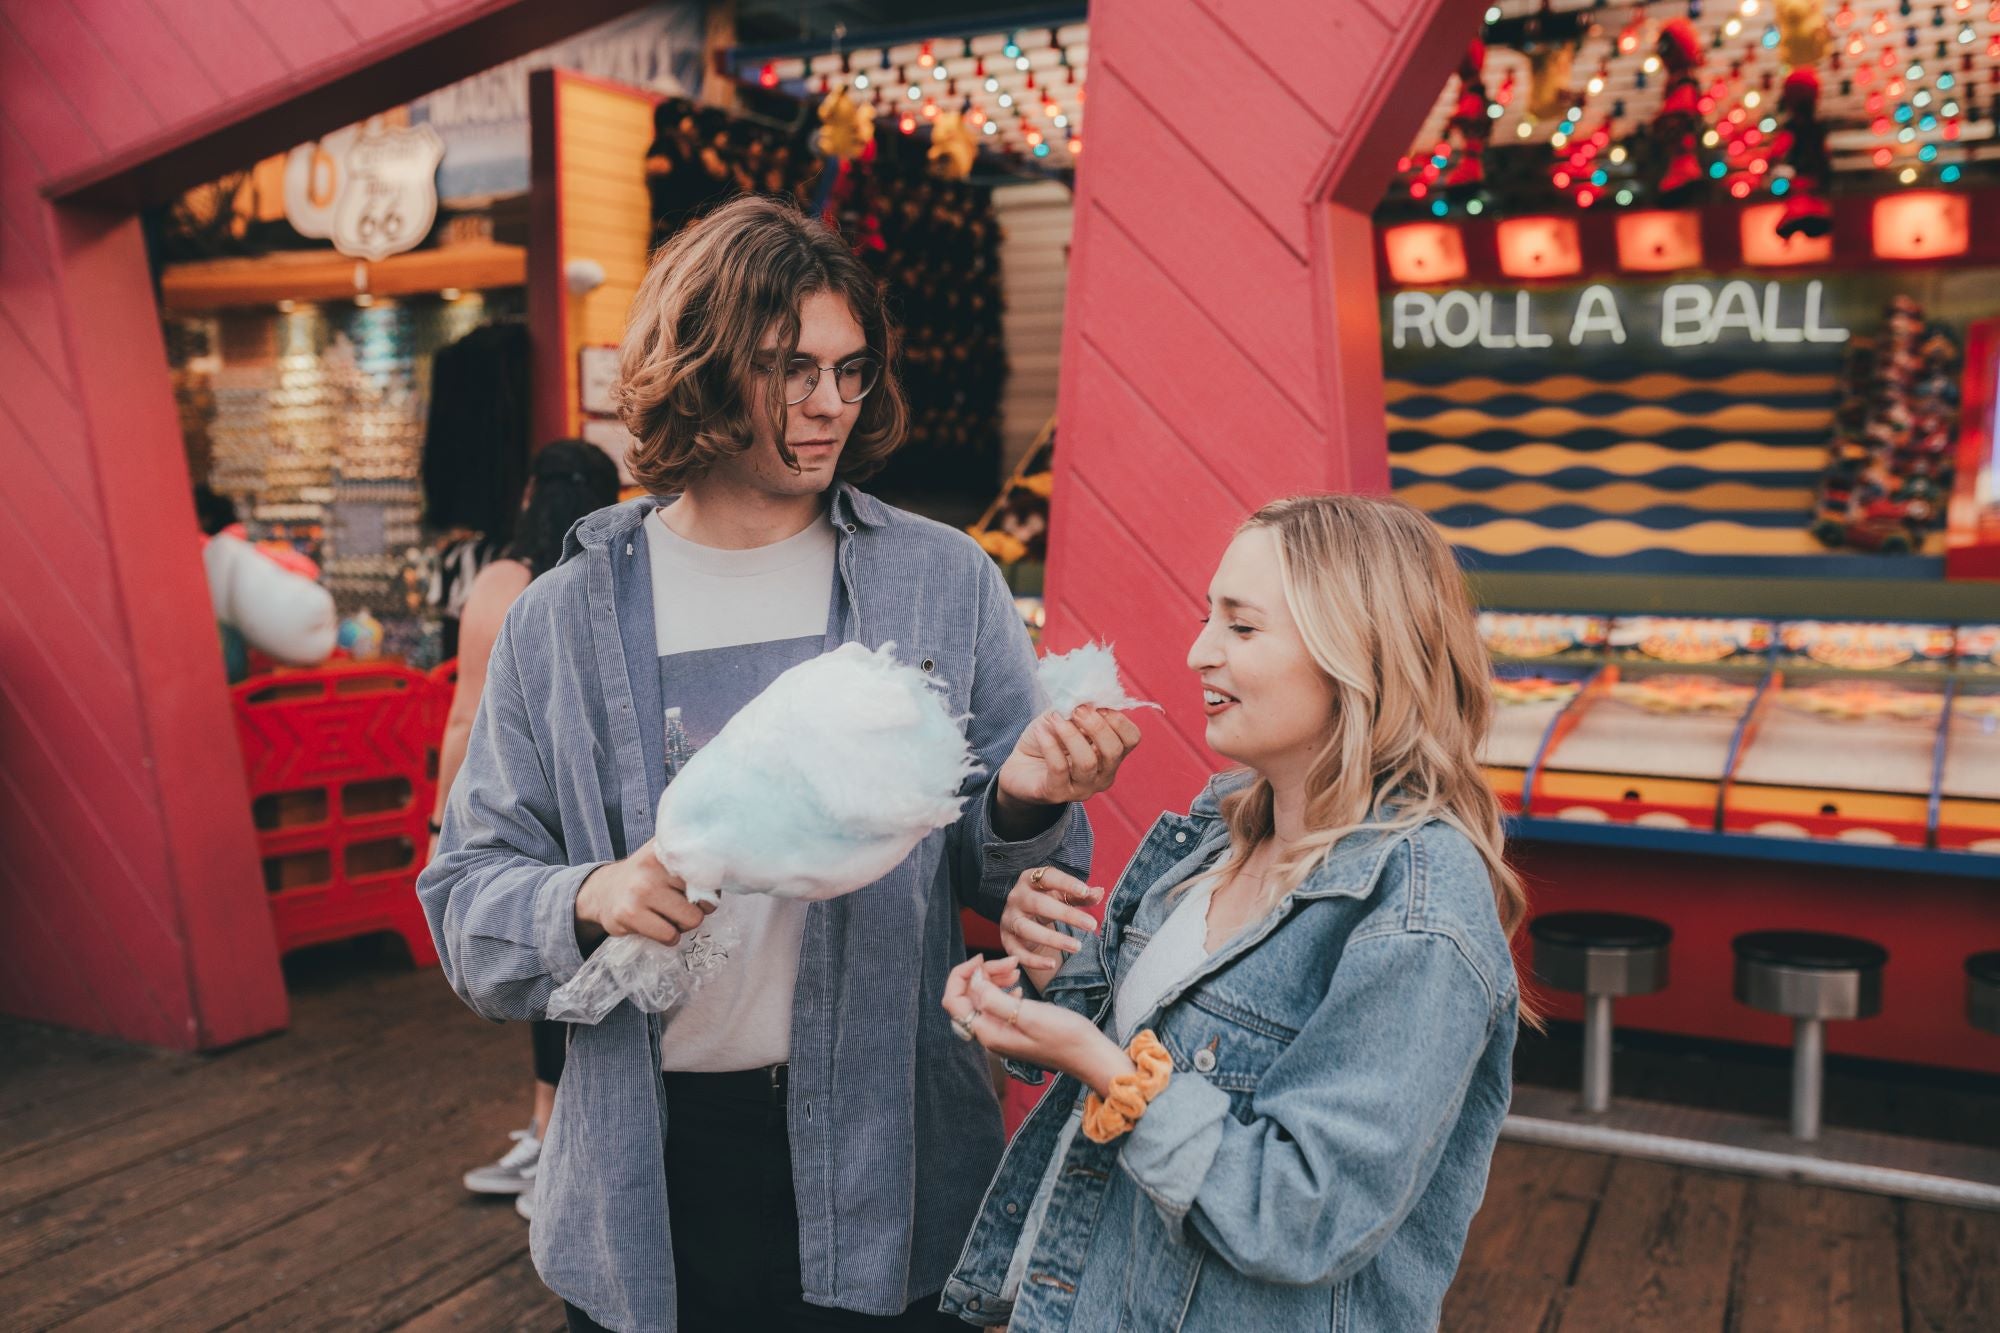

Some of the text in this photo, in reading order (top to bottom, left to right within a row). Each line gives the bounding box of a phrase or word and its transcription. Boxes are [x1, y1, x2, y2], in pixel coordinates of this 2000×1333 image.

[357, 204, 405, 245] 66
[1392, 279, 1850, 349] ROLL A BALL
